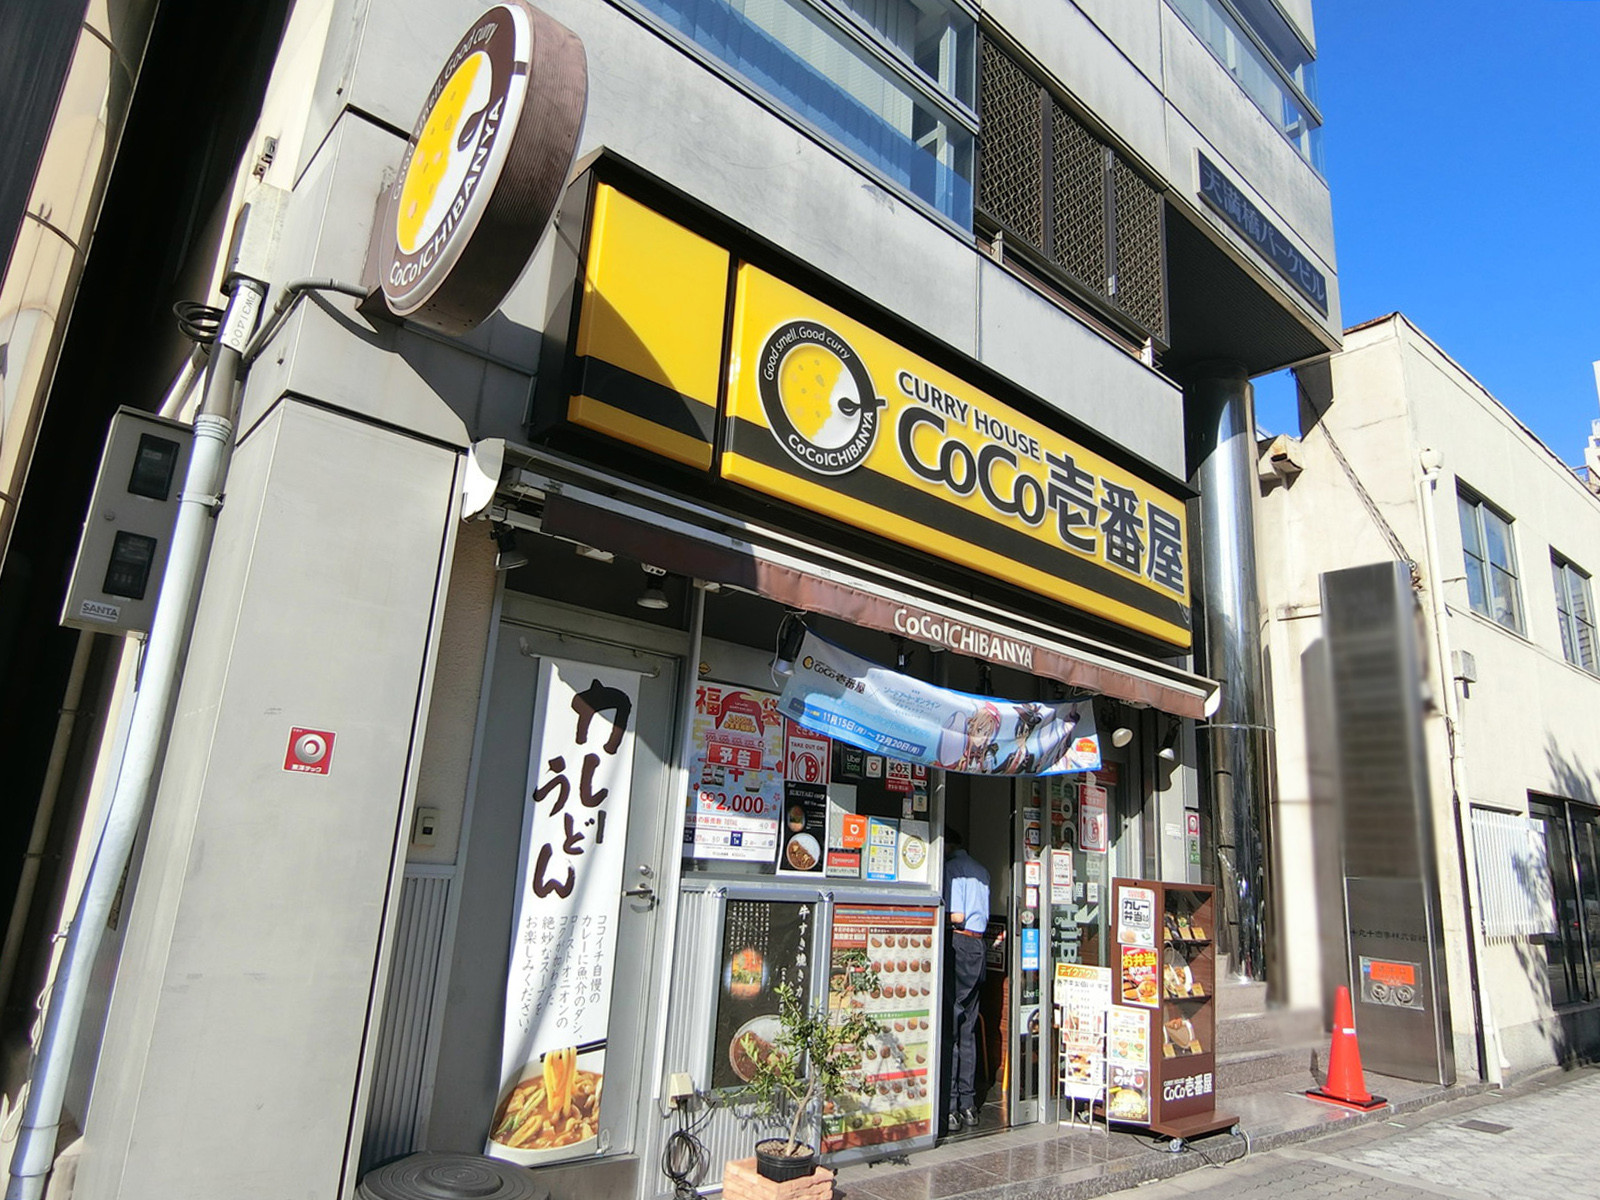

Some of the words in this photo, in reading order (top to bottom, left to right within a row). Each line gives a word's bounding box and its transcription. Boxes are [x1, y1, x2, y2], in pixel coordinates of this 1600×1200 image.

[444, 37, 474, 80] Good
[472, 22, 499, 45] curry
[763, 347, 778, 381] Good
[776, 329, 800, 352] smell.
[798, 326, 826, 342] Good
[825, 335, 851, 360] curry
[787, 411, 874, 467] CoCoICHIBANYA
[898, 370, 970, 424] CURRY
[973, 408, 1042, 461] HOUSE
[898, 406, 1186, 596] CoCo壱番屋
[82, 602, 119, 619] SANTA
[894, 609, 1034, 670] CoCoICHIBANYA
[719, 746, 752, 767] 予告
[1124, 900, 1149, 911] カレー
[589, 915, 607, 1004] ココイチ自慢の
[1123, 952, 1156, 968] お弁当
[1163, 1072, 1213, 1101] CoCo壱番屋
